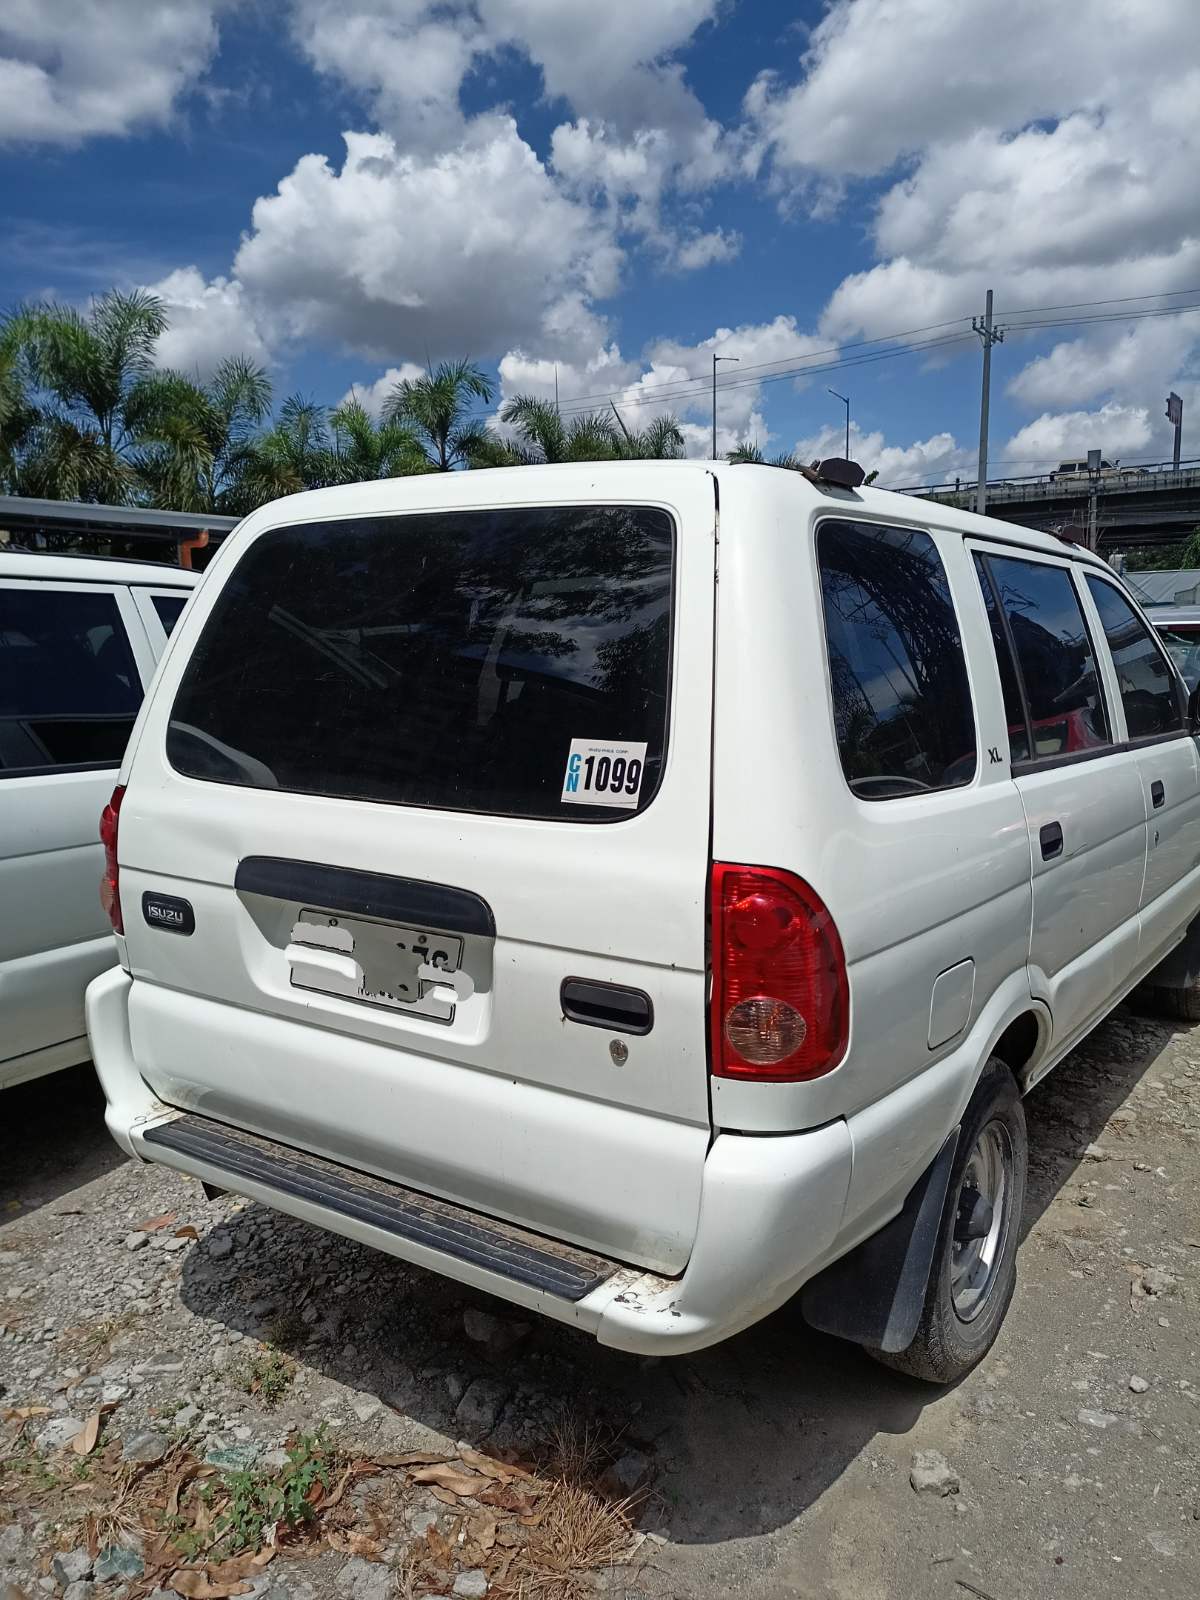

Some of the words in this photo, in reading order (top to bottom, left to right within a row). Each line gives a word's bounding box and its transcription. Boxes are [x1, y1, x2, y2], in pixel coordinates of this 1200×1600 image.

[988, 747, 1003, 764] XL
[584, 756, 642, 795] 1099
[148, 905, 183, 922] ISUZU
